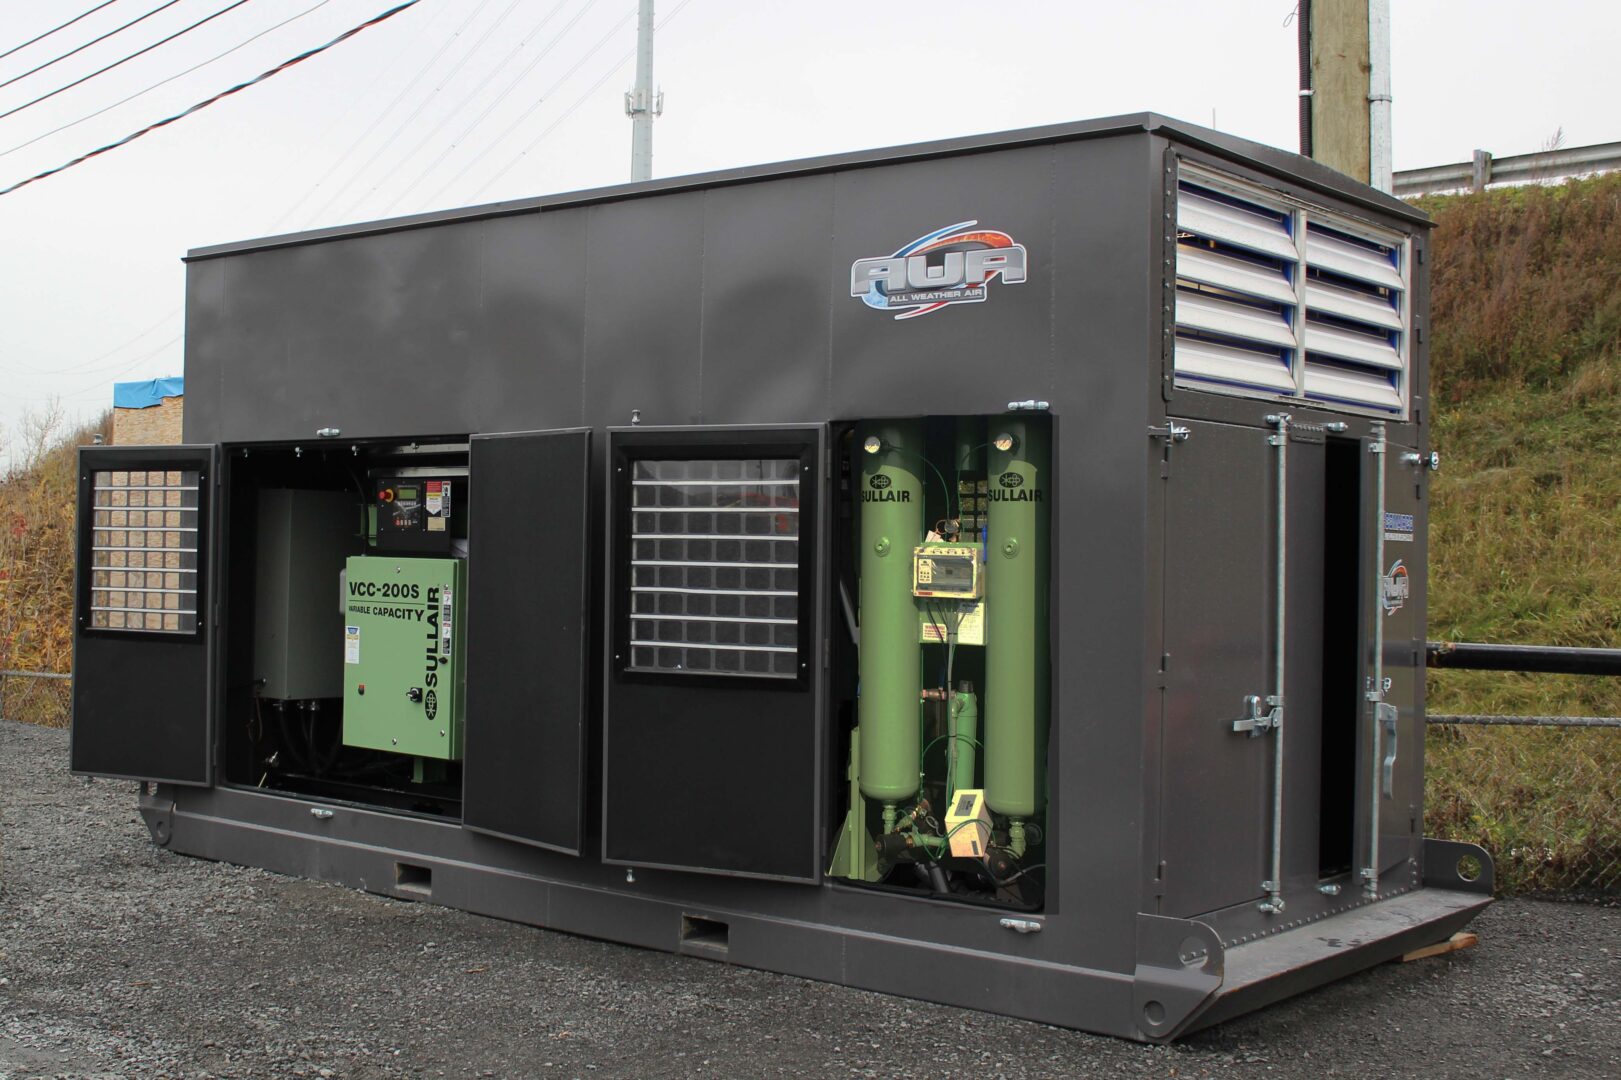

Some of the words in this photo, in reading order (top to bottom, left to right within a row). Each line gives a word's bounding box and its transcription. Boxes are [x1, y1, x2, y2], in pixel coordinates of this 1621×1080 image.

[890, 294, 908, 303] ALL
[911, 290, 961, 301] WEATHER
[964, 289, 983, 298] AIR
[987, 489, 1042, 502] SULLAIR
[349, 581, 420, 599] VCC-200S
[348, 605, 371, 615] VARIABLE
[373, 606, 424, 622] CAPACITY
[425, 586, 440, 688] SULLAIR
